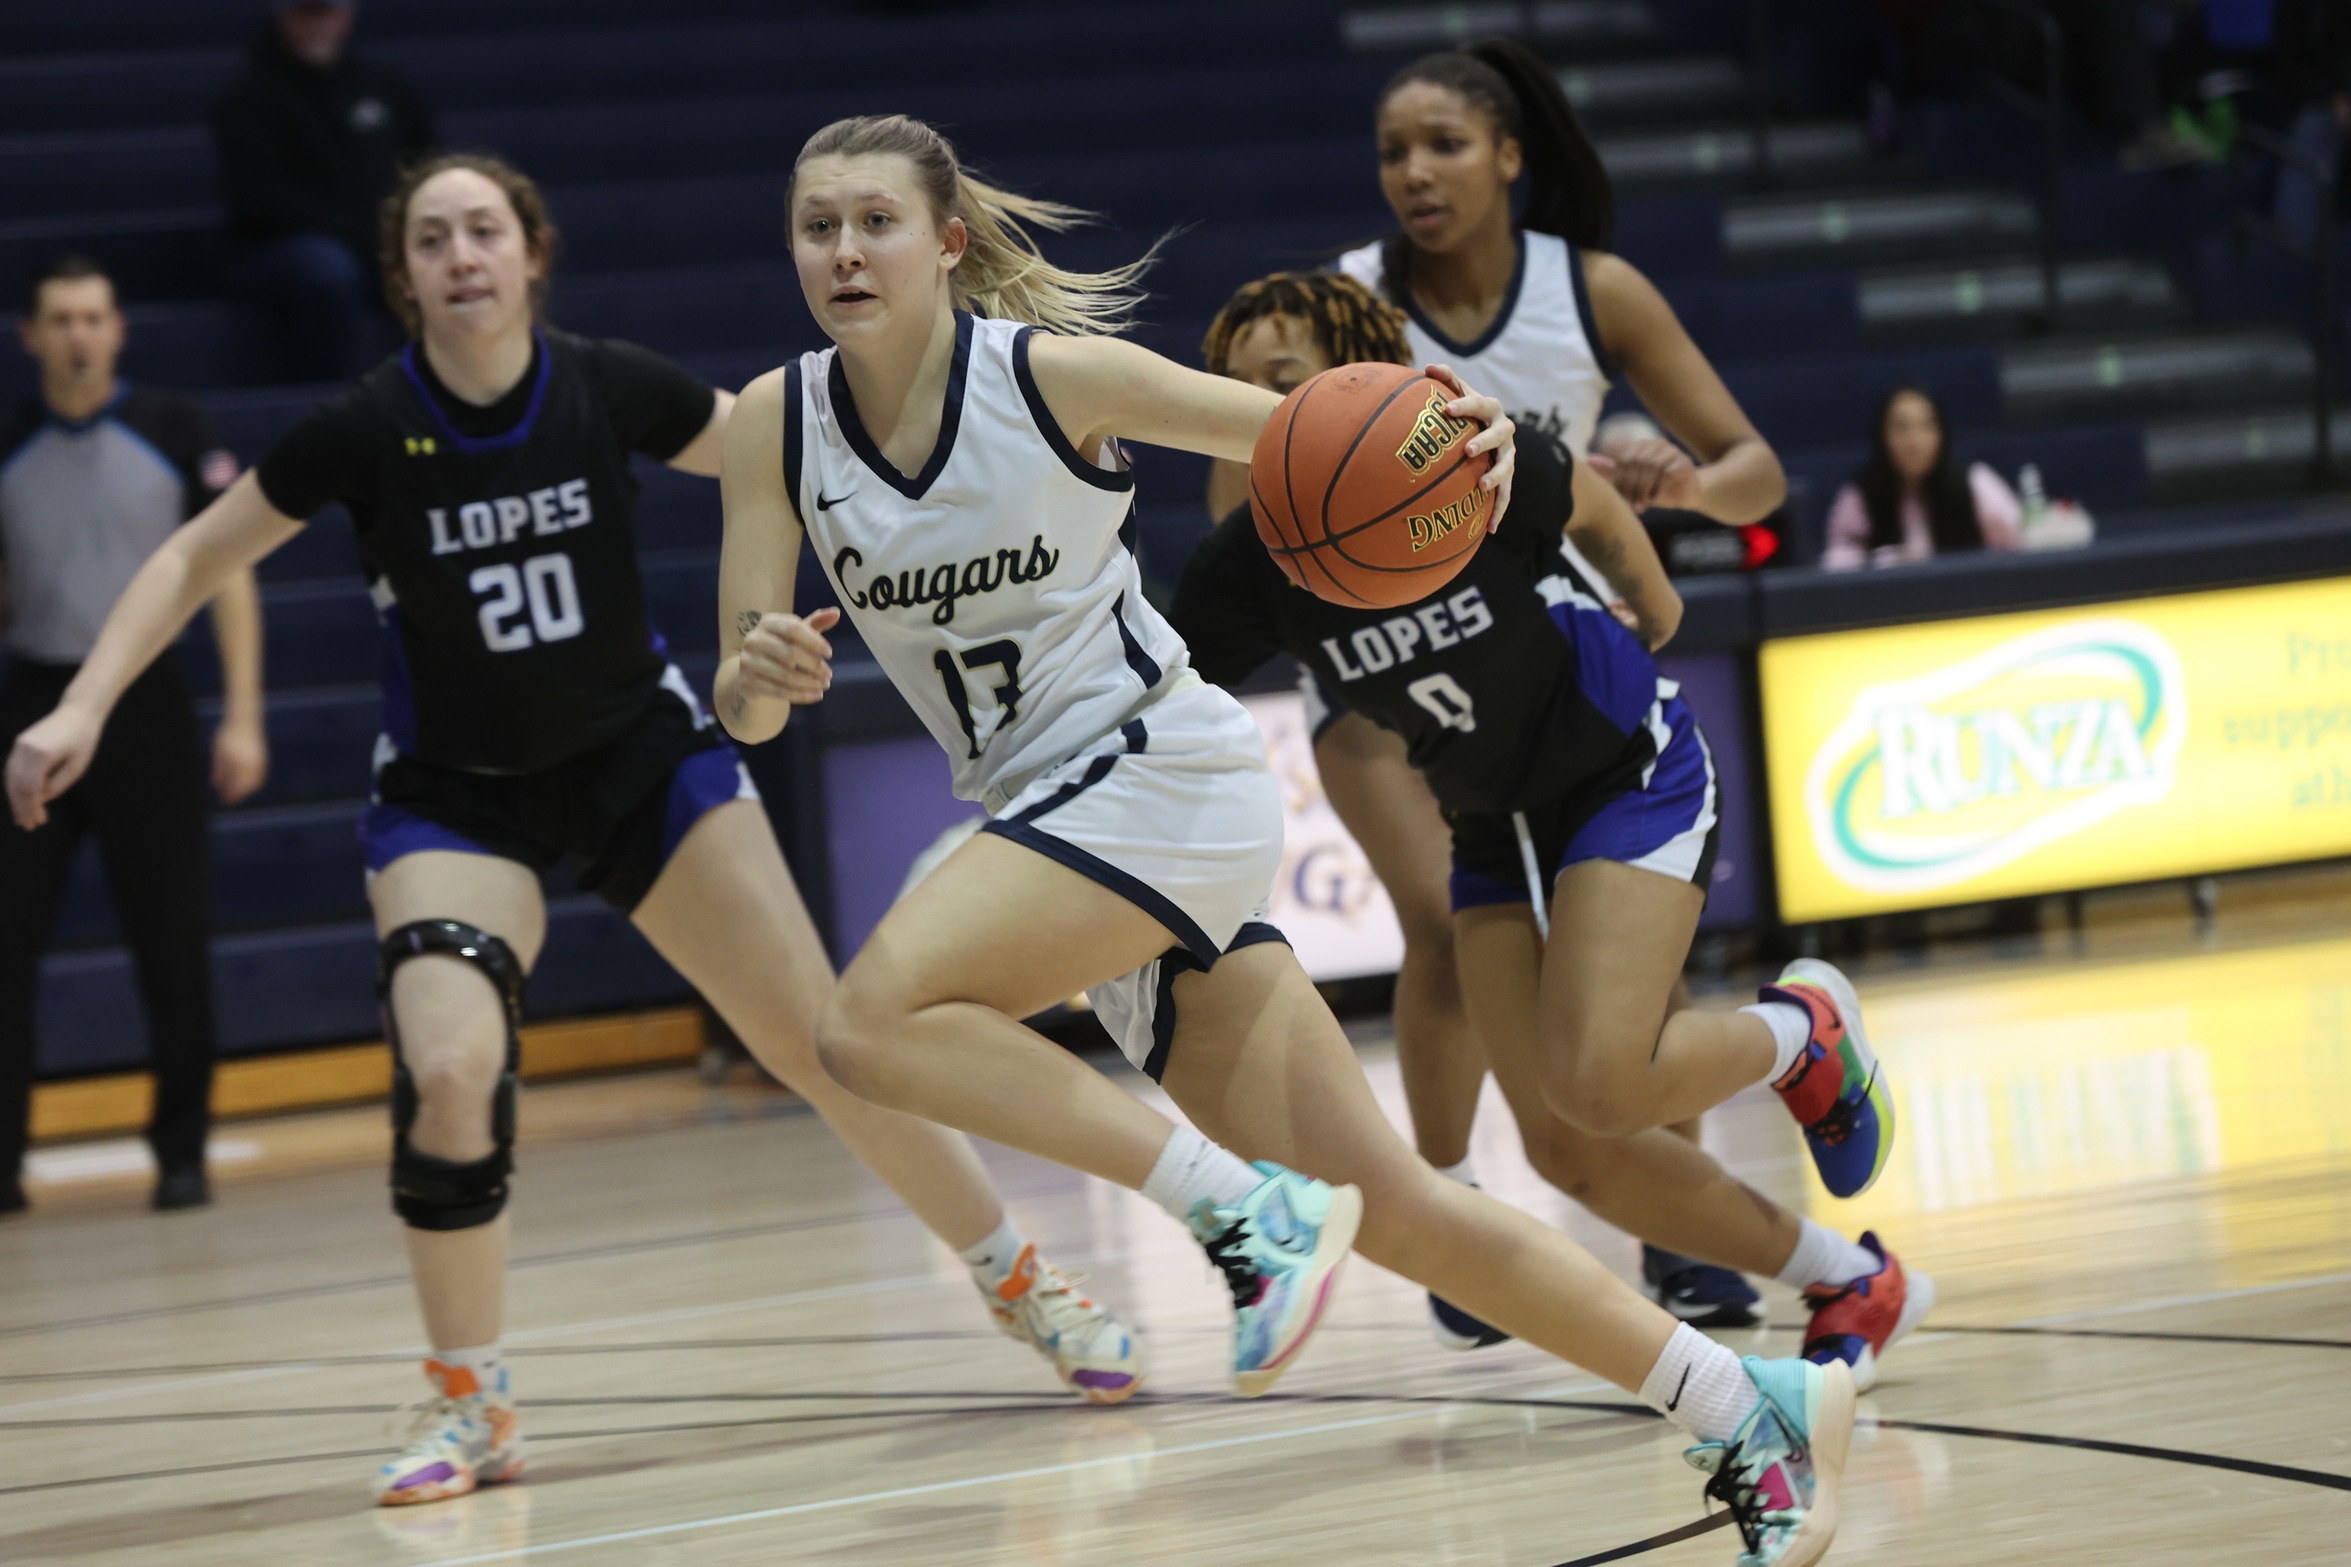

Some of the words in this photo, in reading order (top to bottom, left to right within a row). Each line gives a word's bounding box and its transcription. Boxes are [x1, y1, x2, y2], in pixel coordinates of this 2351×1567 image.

[427, 477, 592, 555] LOPES
[1407, 486, 1491, 551] LDING
[468, 553, 584, 652] 20
[834, 535, 1059, 625] Cougars
[1321, 585, 1494, 682] LOPES
[934, 637, 1022, 760] 13
[1408, 672, 1476, 733] 0
[1874, 697, 2155, 818] RUNZA
